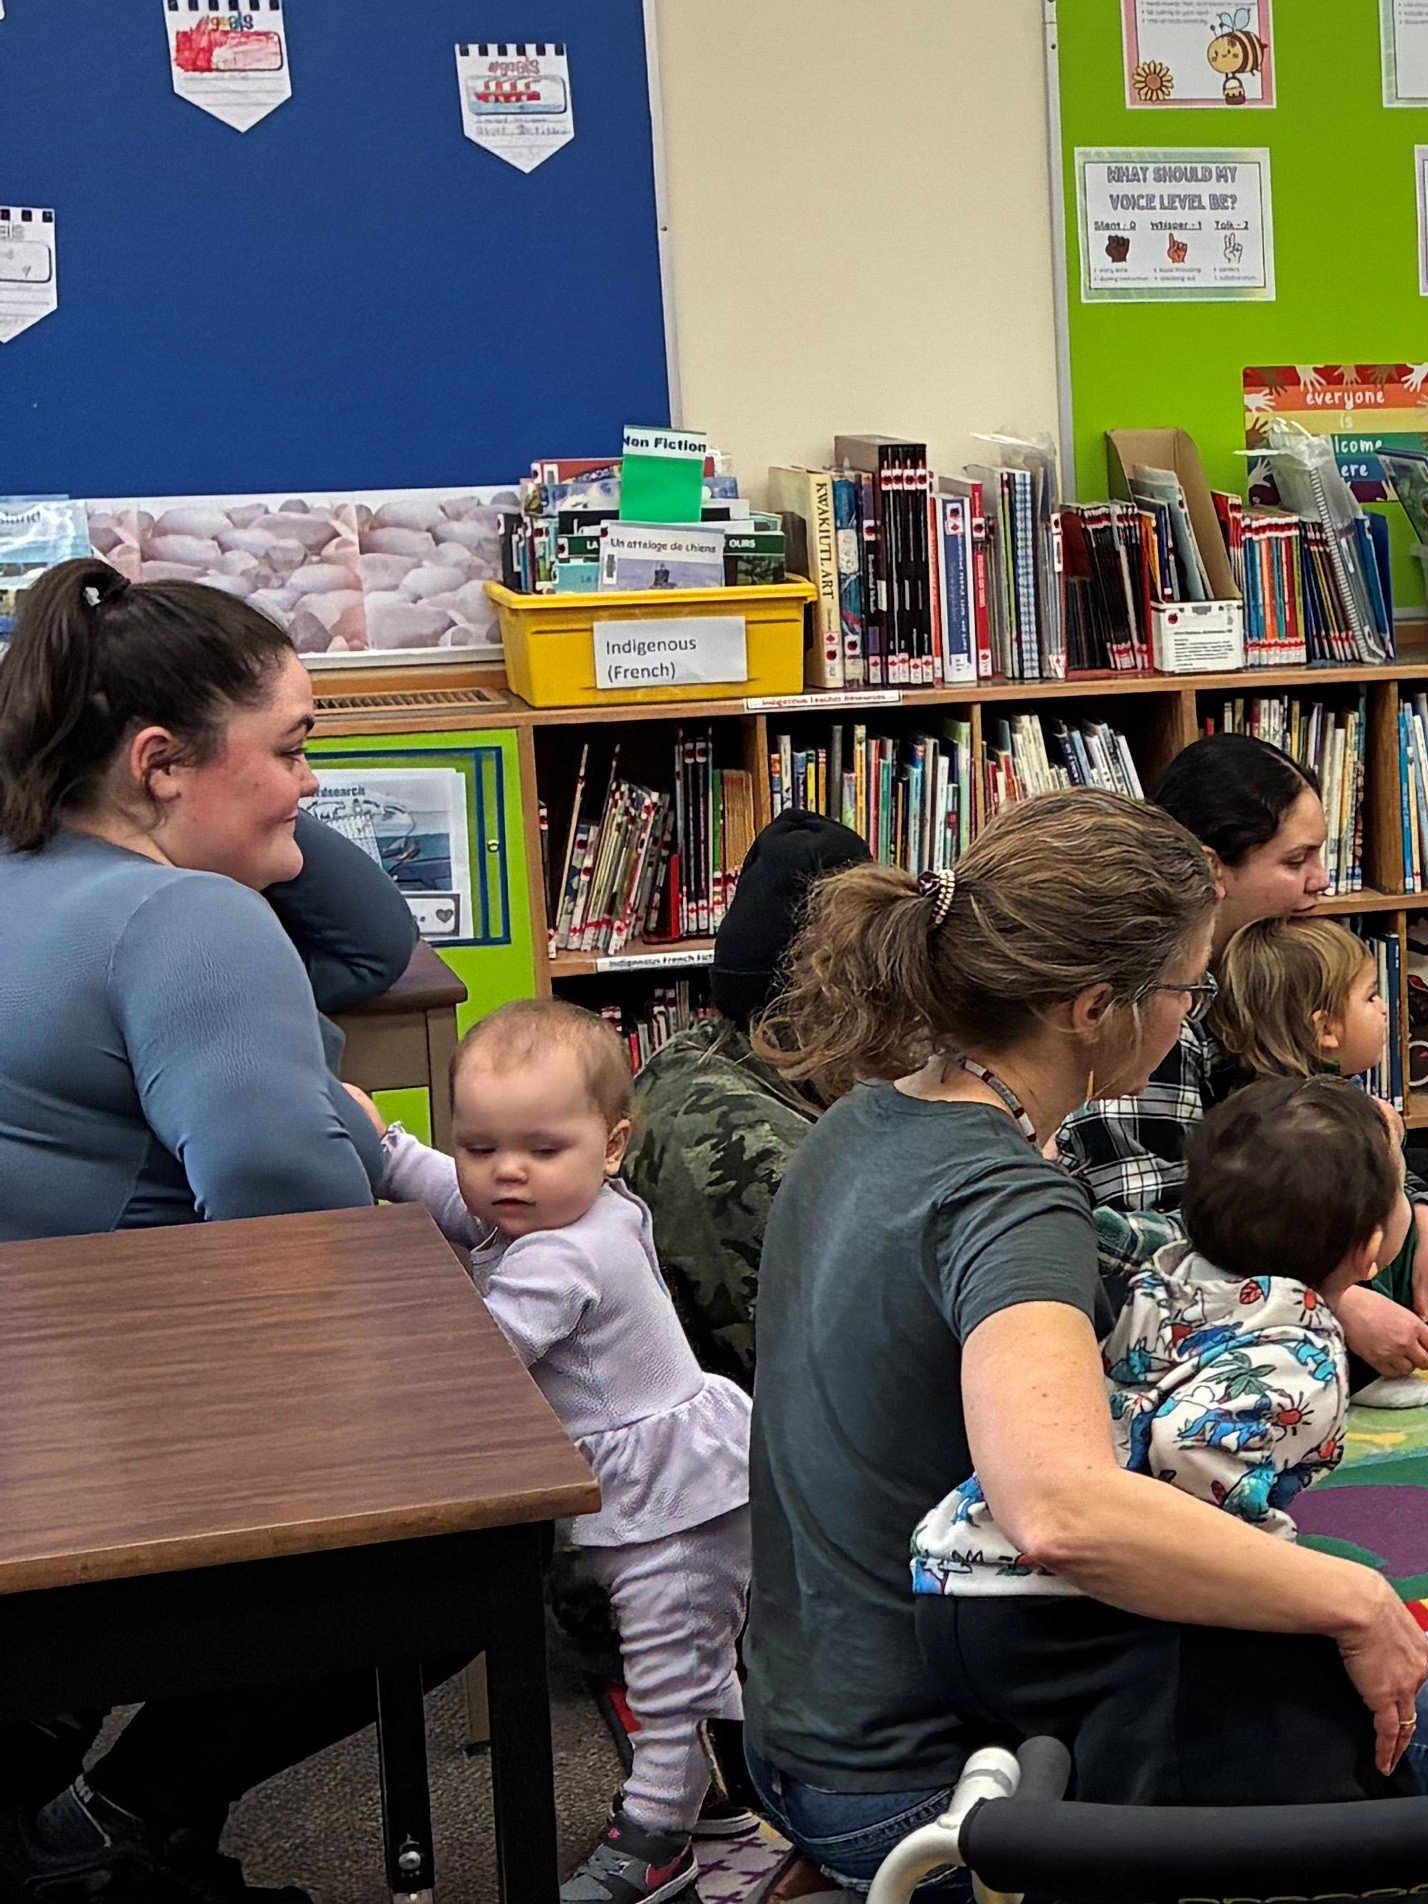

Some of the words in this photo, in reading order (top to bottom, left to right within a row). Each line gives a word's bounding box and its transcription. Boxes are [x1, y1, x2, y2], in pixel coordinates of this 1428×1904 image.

[1107, 165, 1149, 183] WHAT
[1153, 165, 1213, 183] SHOULD
[1215, 165, 1238, 183] MY
[1109, 193, 1156, 211] VOICE
[1159, 193, 1207, 211] LEVEL
[1208, 193, 1238, 211] BE?
[1305, 390, 1385, 411] everyone
[1339, 413, 1354, 429] is
[653, 436, 707, 453] Fiction
[1334, 435, 1383, 454] lcome
[1341, 463, 1369, 477] ere
[815, 482, 833, 570] KWAKIUTL
[610, 537, 625, 549] Un
[670, 541, 684, 551] de
[685, 542, 717, 554] chiens
[728, 538, 756, 549] OURS
[819, 573, 835, 600] ART
[605, 638, 697, 656] Indigenous
[607, 661, 676, 683] (French)
[317, 785, 366, 797] rdsearch
